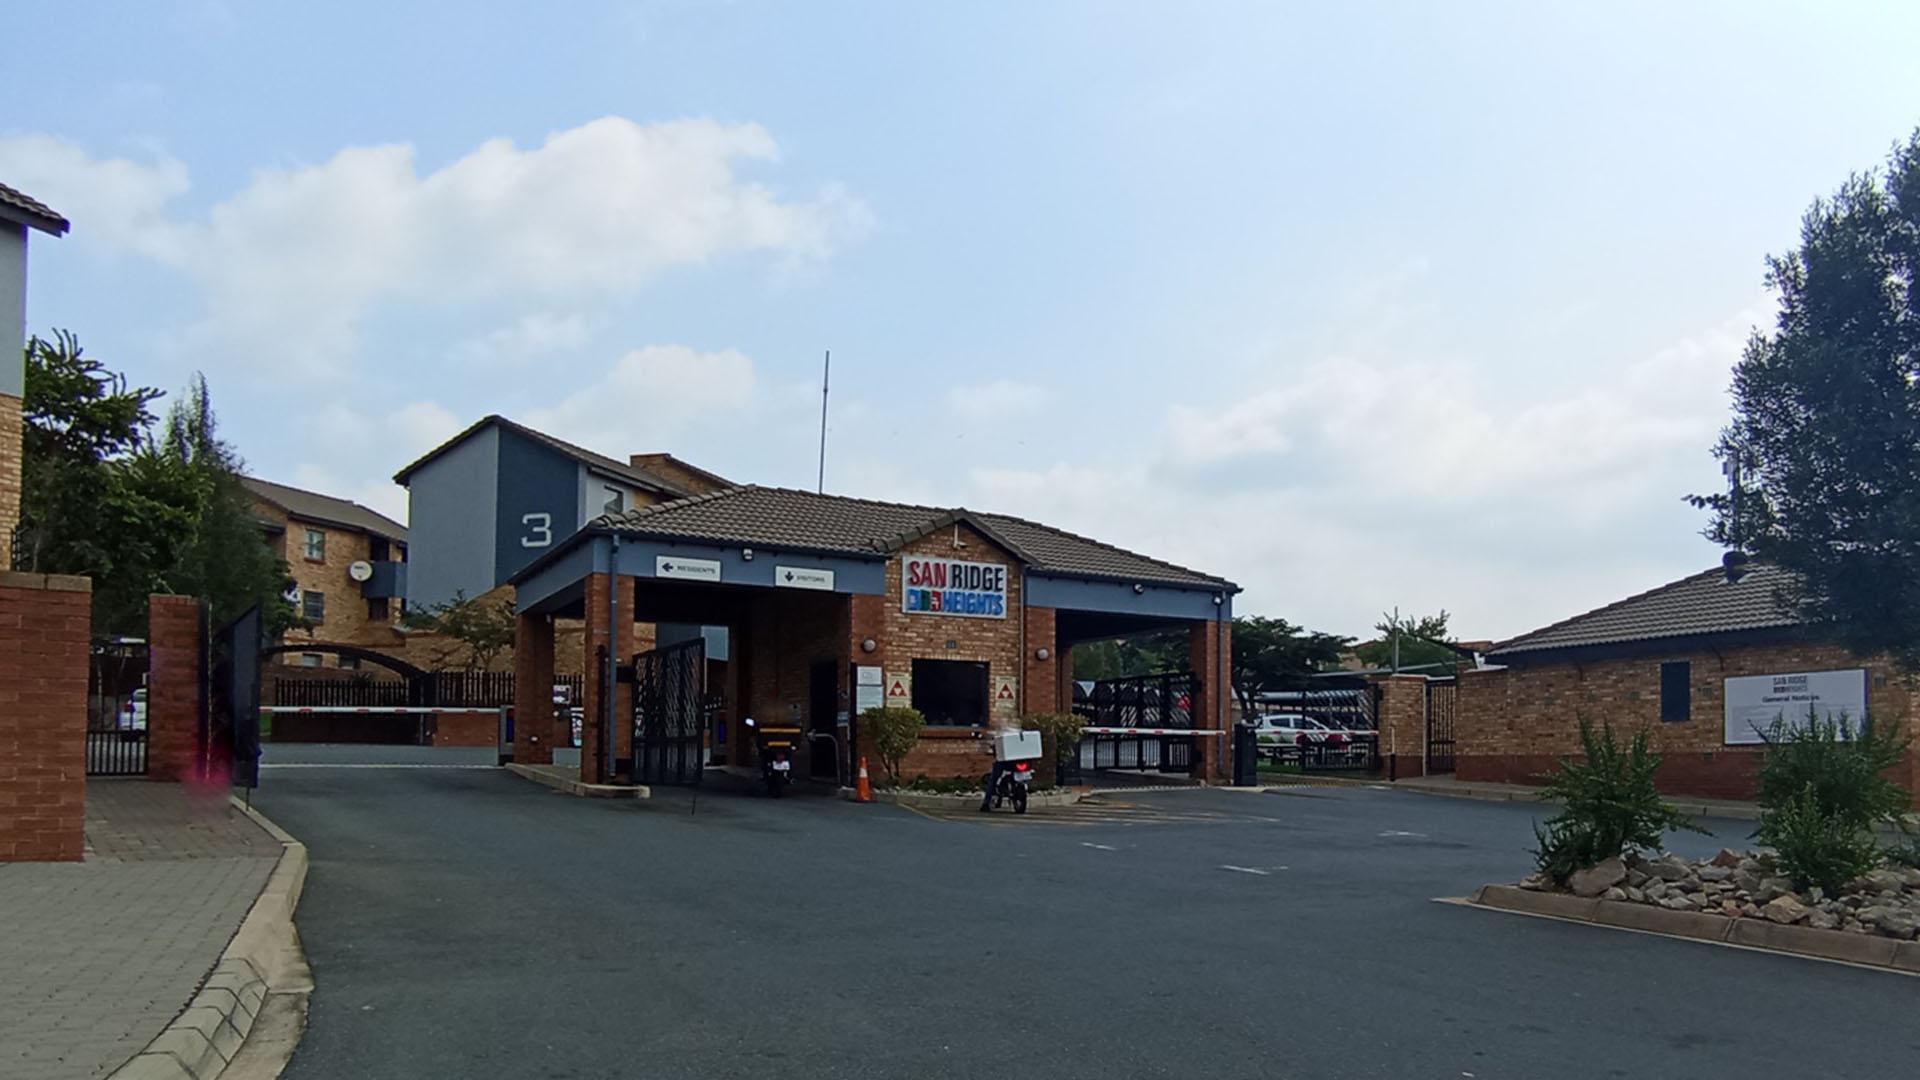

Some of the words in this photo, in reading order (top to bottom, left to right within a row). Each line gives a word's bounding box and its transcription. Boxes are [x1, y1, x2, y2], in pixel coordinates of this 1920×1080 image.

[521, 513, 552, 548] 3
[908, 561, 947, 587] SAN
[951, 564, 1004, 592] RIDGE
[943, 590, 1004, 616] HEIGHTS
